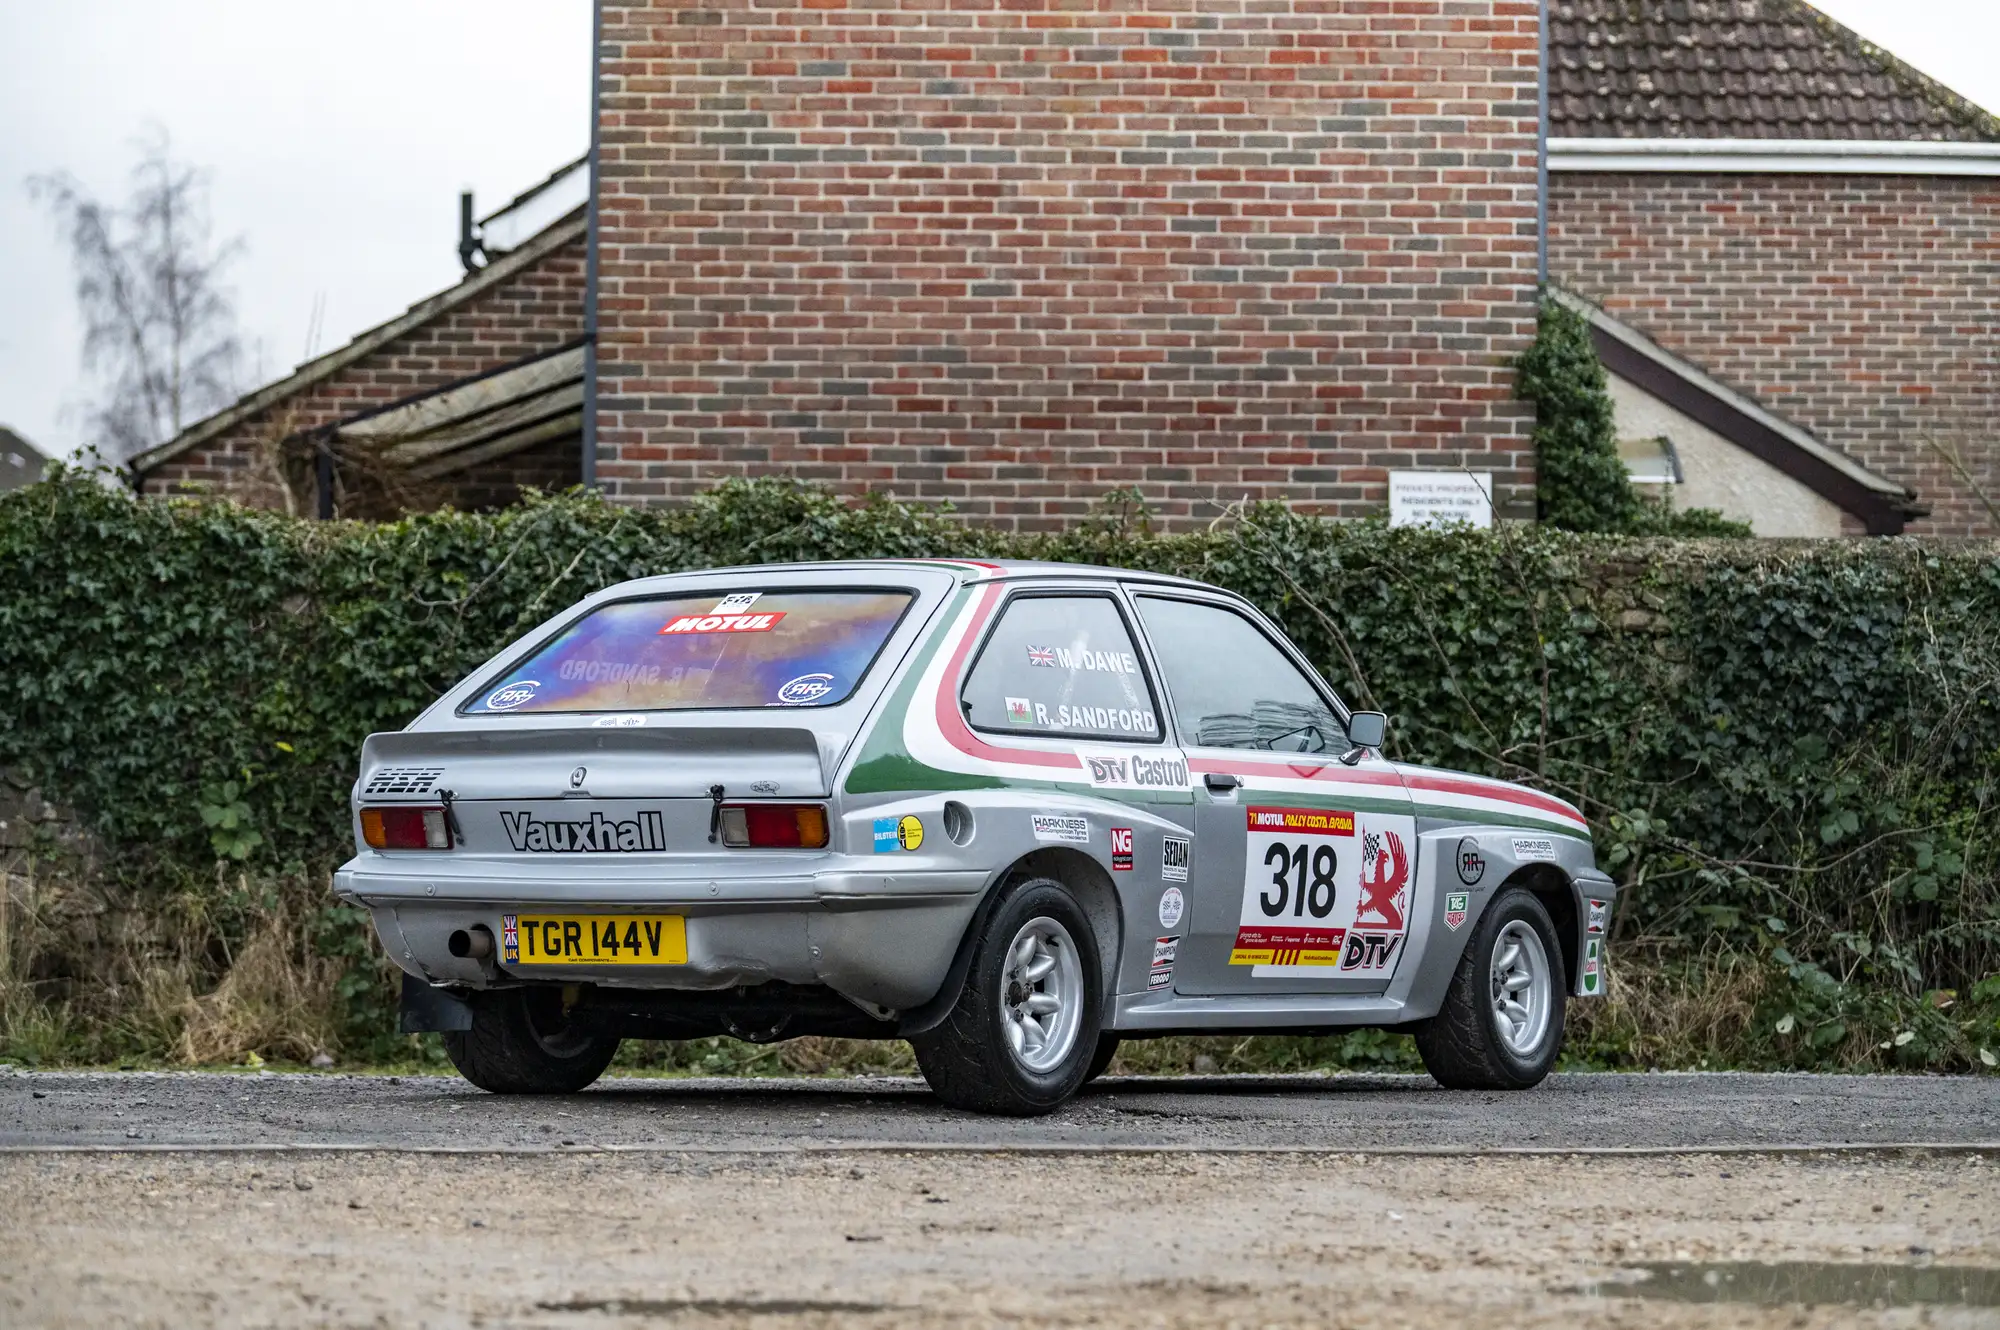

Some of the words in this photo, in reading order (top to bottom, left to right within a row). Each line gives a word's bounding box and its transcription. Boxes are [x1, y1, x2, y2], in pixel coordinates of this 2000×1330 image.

[664, 615, 775, 632] MOTUL
[1082, 651, 1136, 674] DAWE
[1034, 702, 1054, 725] R.
[1058, 705, 1157, 732] SANDFORD
[1085, 756, 1129, 783] DTV
[1131, 755, 1189, 786] Castrol
[500, 811, 666, 852] Vauxhall
[1033, 817, 1086, 829] HARKNESS
[1249, 812, 1257, 825] 71
[1257, 813, 1284, 826] MOTUL
[1284, 814, 1306, 827] RALLY
[1306, 816, 1328, 828] COSTA
[1328, 817, 1353, 830] BRAVA
[1112, 830, 1132, 853] NG
[1513, 840, 1552, 850] HARKNESS
[1163, 840, 1188, 868] SEDAN
[1260, 842, 1337, 918] 318
[1450, 897, 1464, 910] TAG
[521, 920, 582, 956] TGR
[591, 920, 662, 957] 144V
[506, 949, 518, 960] UK
[1155, 945, 1176, 957] CHAMPION
[1341, 932, 1404, 971] DTV
[1150, 972, 1170, 985] FERODO
